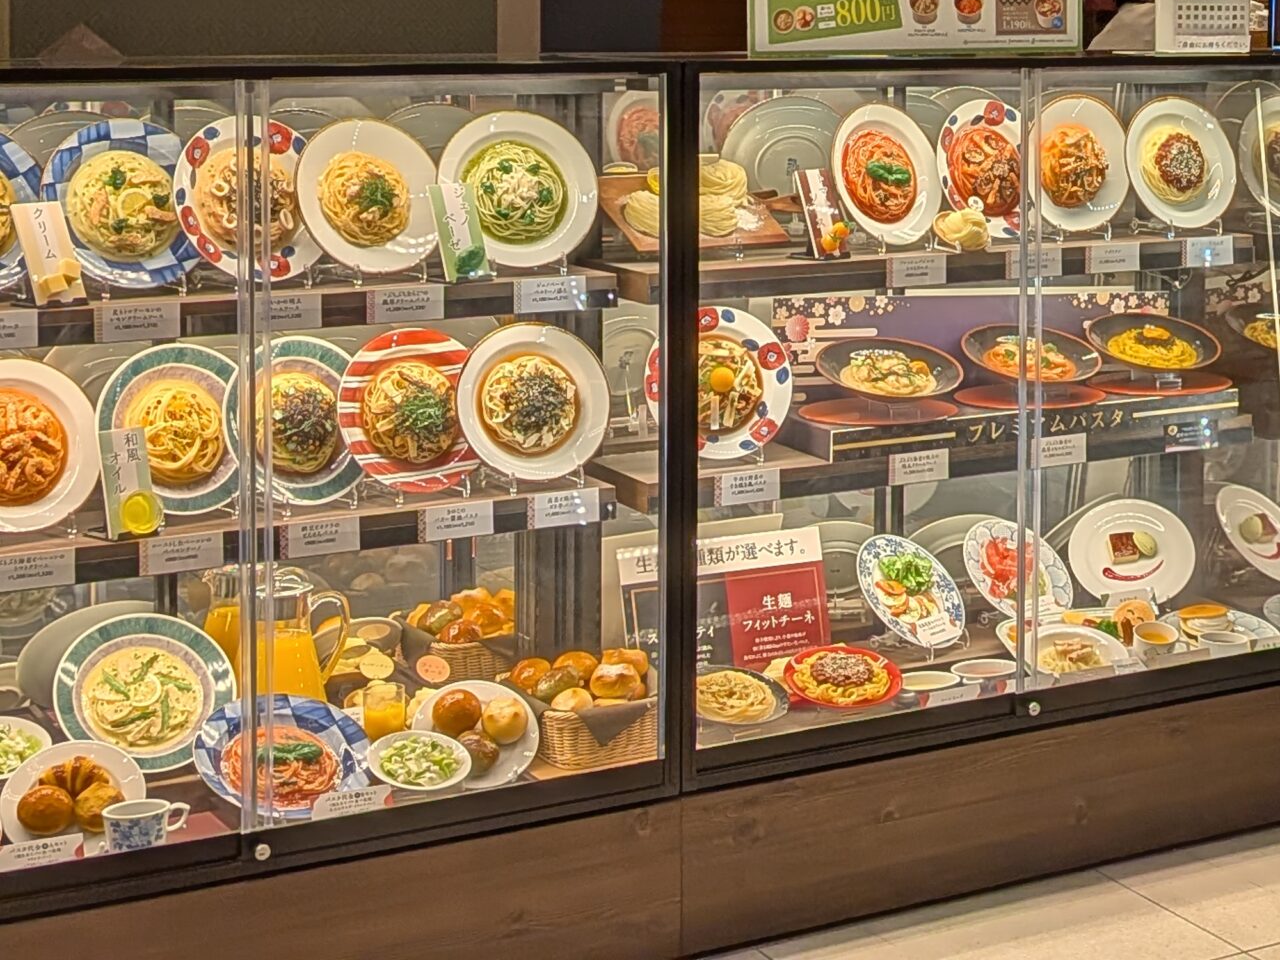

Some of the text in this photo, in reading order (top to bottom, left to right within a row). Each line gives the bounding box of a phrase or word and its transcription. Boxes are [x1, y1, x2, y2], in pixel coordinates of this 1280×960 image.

[32, 207, 57, 260] クリーム
[123, 432, 142, 462] 和風
[108, 452, 127, 495] オイル
[761, 592, 793, 611] 生麺
[743, 610, 816, 633] フィットチーネ
